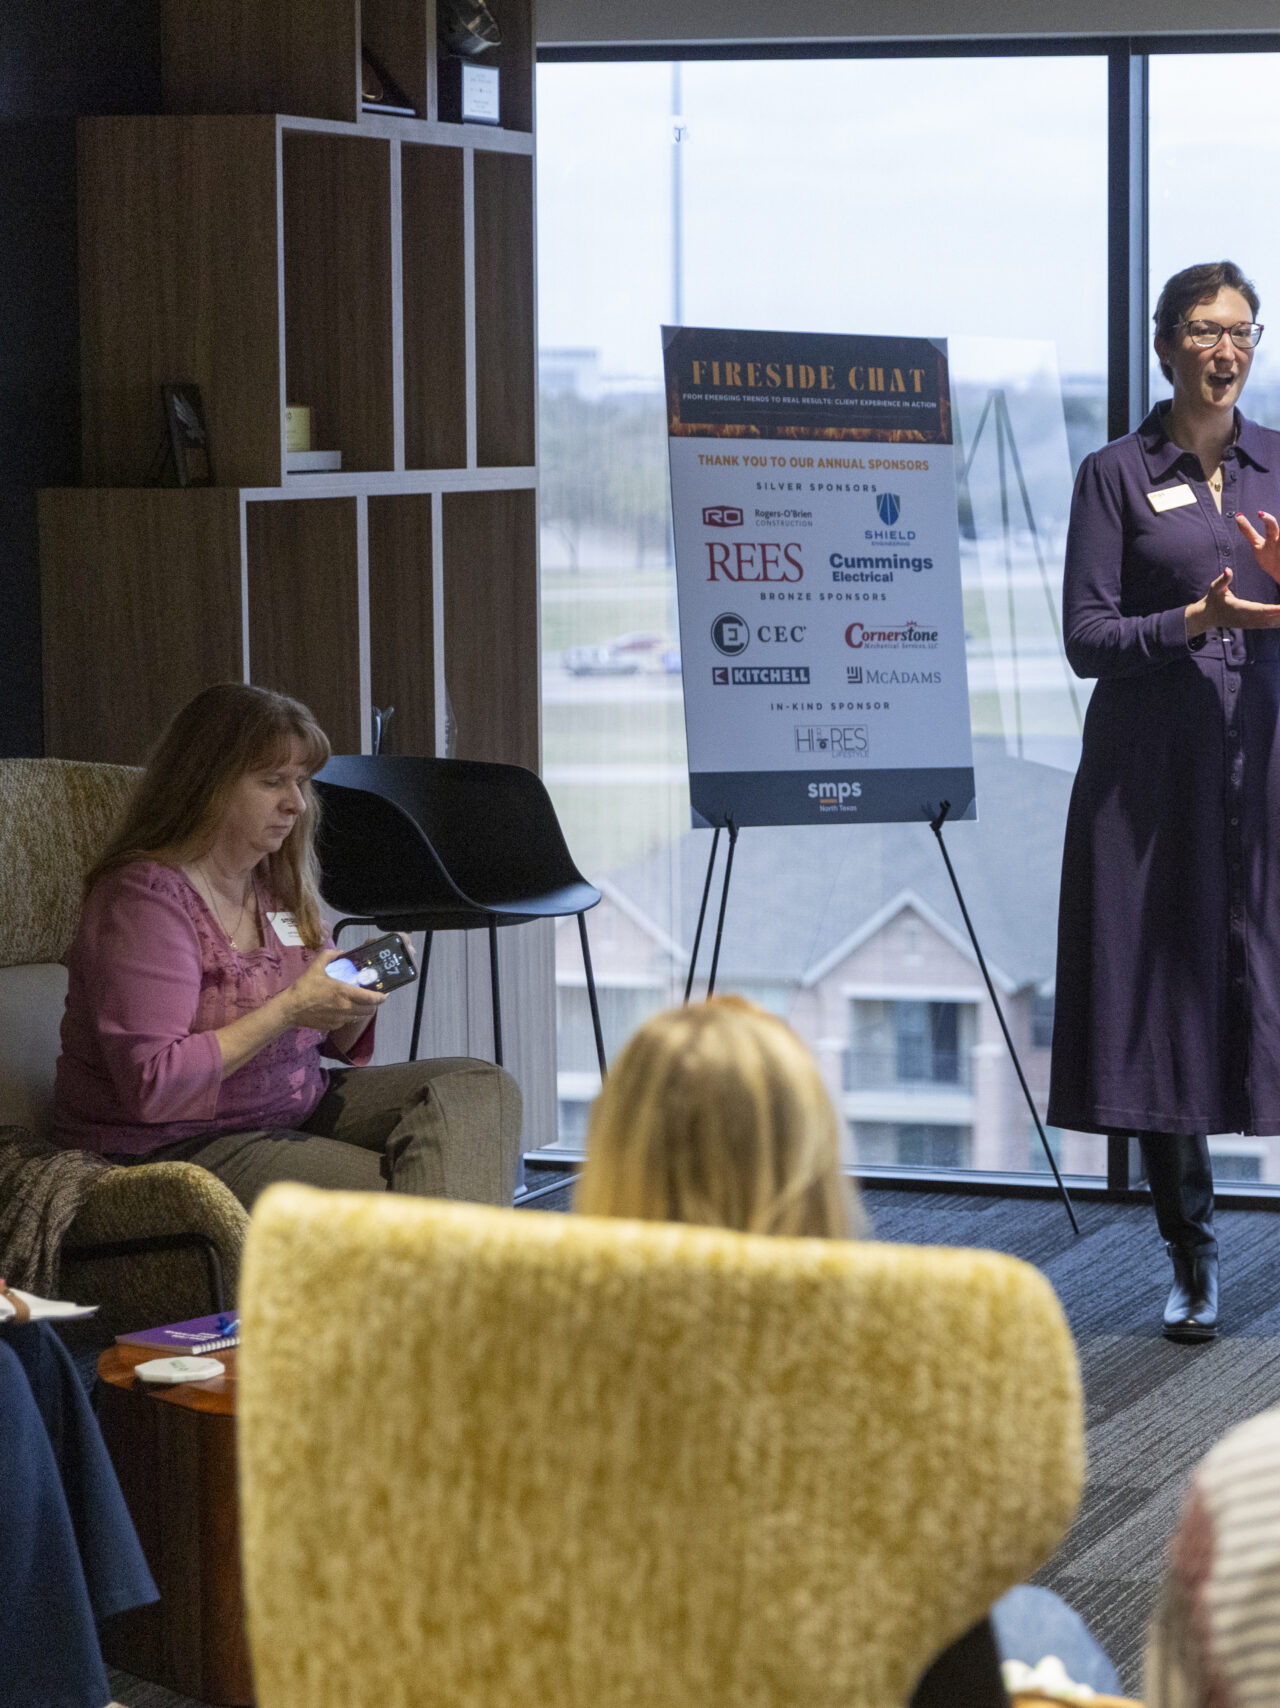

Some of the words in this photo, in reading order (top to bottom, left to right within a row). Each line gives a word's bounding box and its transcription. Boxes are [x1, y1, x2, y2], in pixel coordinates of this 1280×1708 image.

[692, 360, 836, 390] FIRESIDE
[848, 366, 925, 393] CHAT
[742, 395, 769, 403] TRENDS
[782, 396, 800, 404] REAL
[834, 398, 859, 406] CLIENT
[860, 399, 900, 407] EXPERIENCE
[698, 454, 740, 466] THANK
[742, 456, 767, 467] YOU
[770, 456, 786, 467] TO
[789, 457, 814, 468] OUR
[817, 457, 866, 469] ANNUAL
[868, 459, 929, 471] SPONSORS
[756, 482, 802, 491] SILVER
[810, 483, 877, 492] SPONSORS
[755, 508, 812, 519] Rogers-O'Brien
[864, 530, 916, 540] SHIELD
[705, 542, 804, 583] REES
[829, 553, 933, 572] Cummings
[832, 571, 893, 582] Electrical
[760, 592, 812, 601] BRONZE
[819, 593, 887, 601] SPONSORS
[757, 625, 804, 643] CEC
[845, 622, 938, 649] Cornerstone
[733, 668, 809, 683] KITCHELL
[771, 702, 823, 711] IN-KIND
[831, 702, 890, 711] SPONSOR
[808, 782, 862, 803] smps
[379, 948, 400, 975] 8:37
